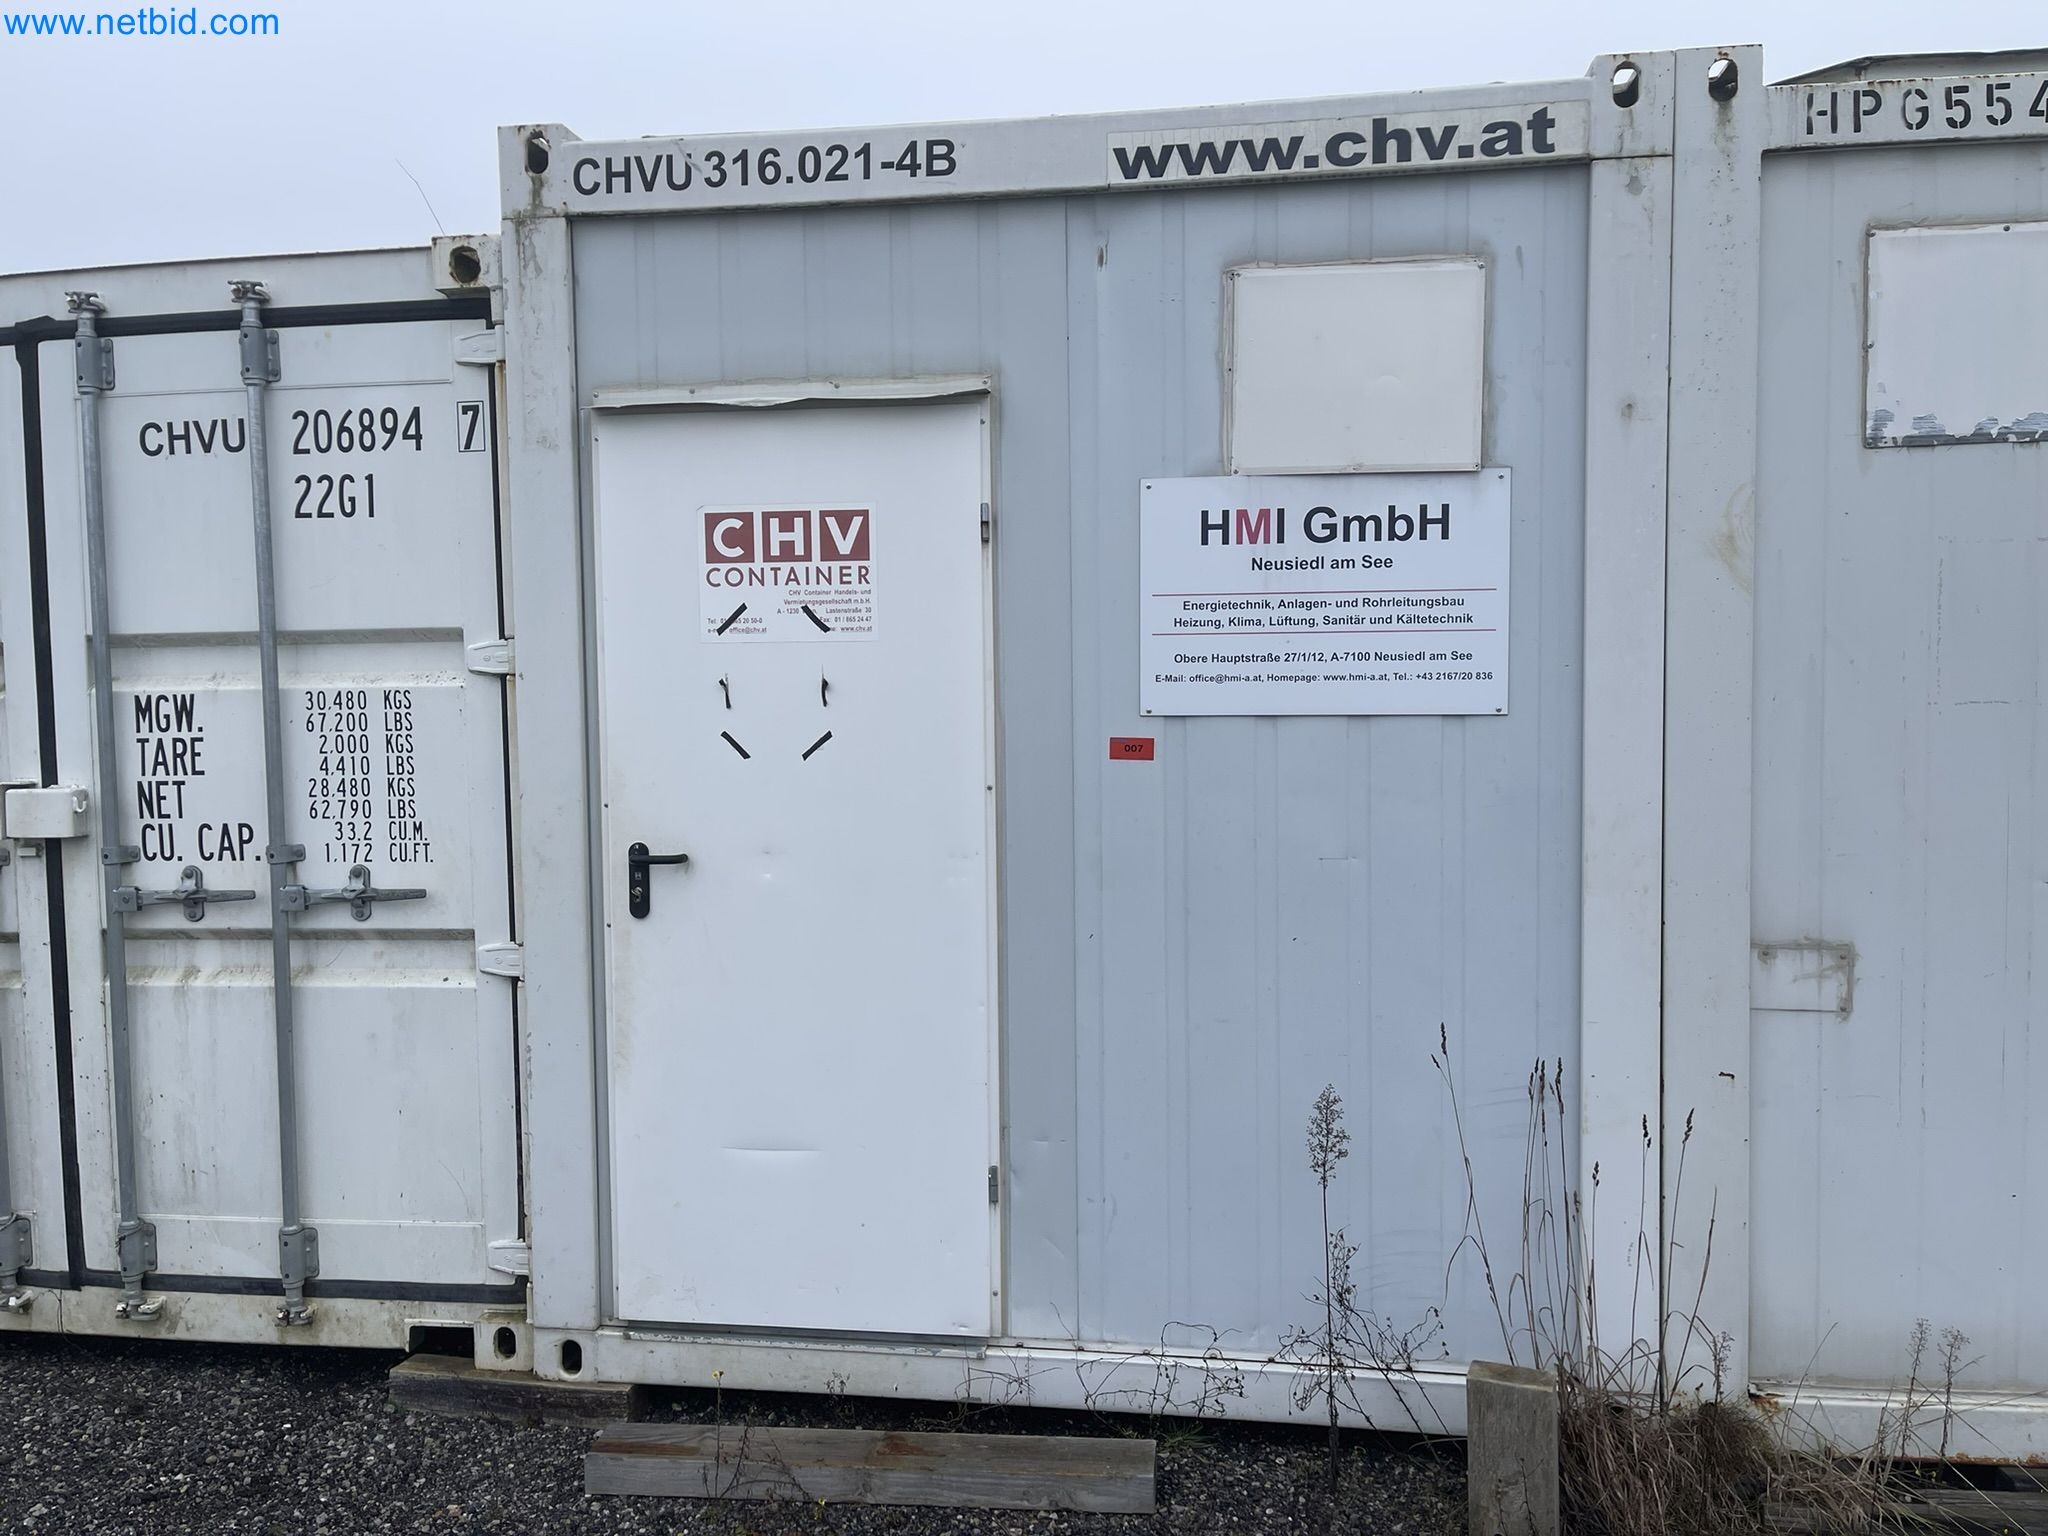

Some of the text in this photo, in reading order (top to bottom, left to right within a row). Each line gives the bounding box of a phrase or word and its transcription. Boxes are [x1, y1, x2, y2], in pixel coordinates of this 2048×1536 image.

[1112, 106, 1556, 180] www.chv.at
[572, 139, 957, 196] CHVU 316.021-4B
[139, 404, 482, 457] CHVU 206894 7
[294, 473, 376, 519] 22G1
[1200, 503, 1450, 546] HMI GmbH
[711, 514, 866, 559] CHV
[1251, 555, 1393, 571] Neusiedl am See
[706, 565, 871, 588] CONTAINER
[1183, 597, 1464, 612] Energietechnik, Anlagen- und Rohrleitungsbau
[1174, 613, 1473, 629] Heizung, Klima, Lüftung, Sanitär und Kältetechnik
[1174, 650, 1473, 665] Obere Hauptstraße 27/1/12, A-7100 Neusiedl am See
[1155, 672, 1493, 684] E-Mail: office@hmi-a.at, Homepage: www.hmi-a.at, Tel.: +43 2167/20 836
[305, 689, 412, 711] 30,480 KGS
[134, 693, 203, 733] MGW.
[306, 711, 413, 733] 67,200 LBS
[319, 733, 414, 755] 2,000 KGS
[1124, 744, 1144, 753] 007
[136, 737, 205, 777] TARE
[319, 755, 415, 777] 4,410 LBS
[308, 777, 416, 798] 28,480 KGS
[137, 780, 186, 819] NET
[309, 799, 417, 821] 62,790 LBS
[141, 822, 261, 862] CU. CAP.
[334, 821, 428, 841] 33.2 CU.M.
[389, 842, 434, 864] CU.FT.
